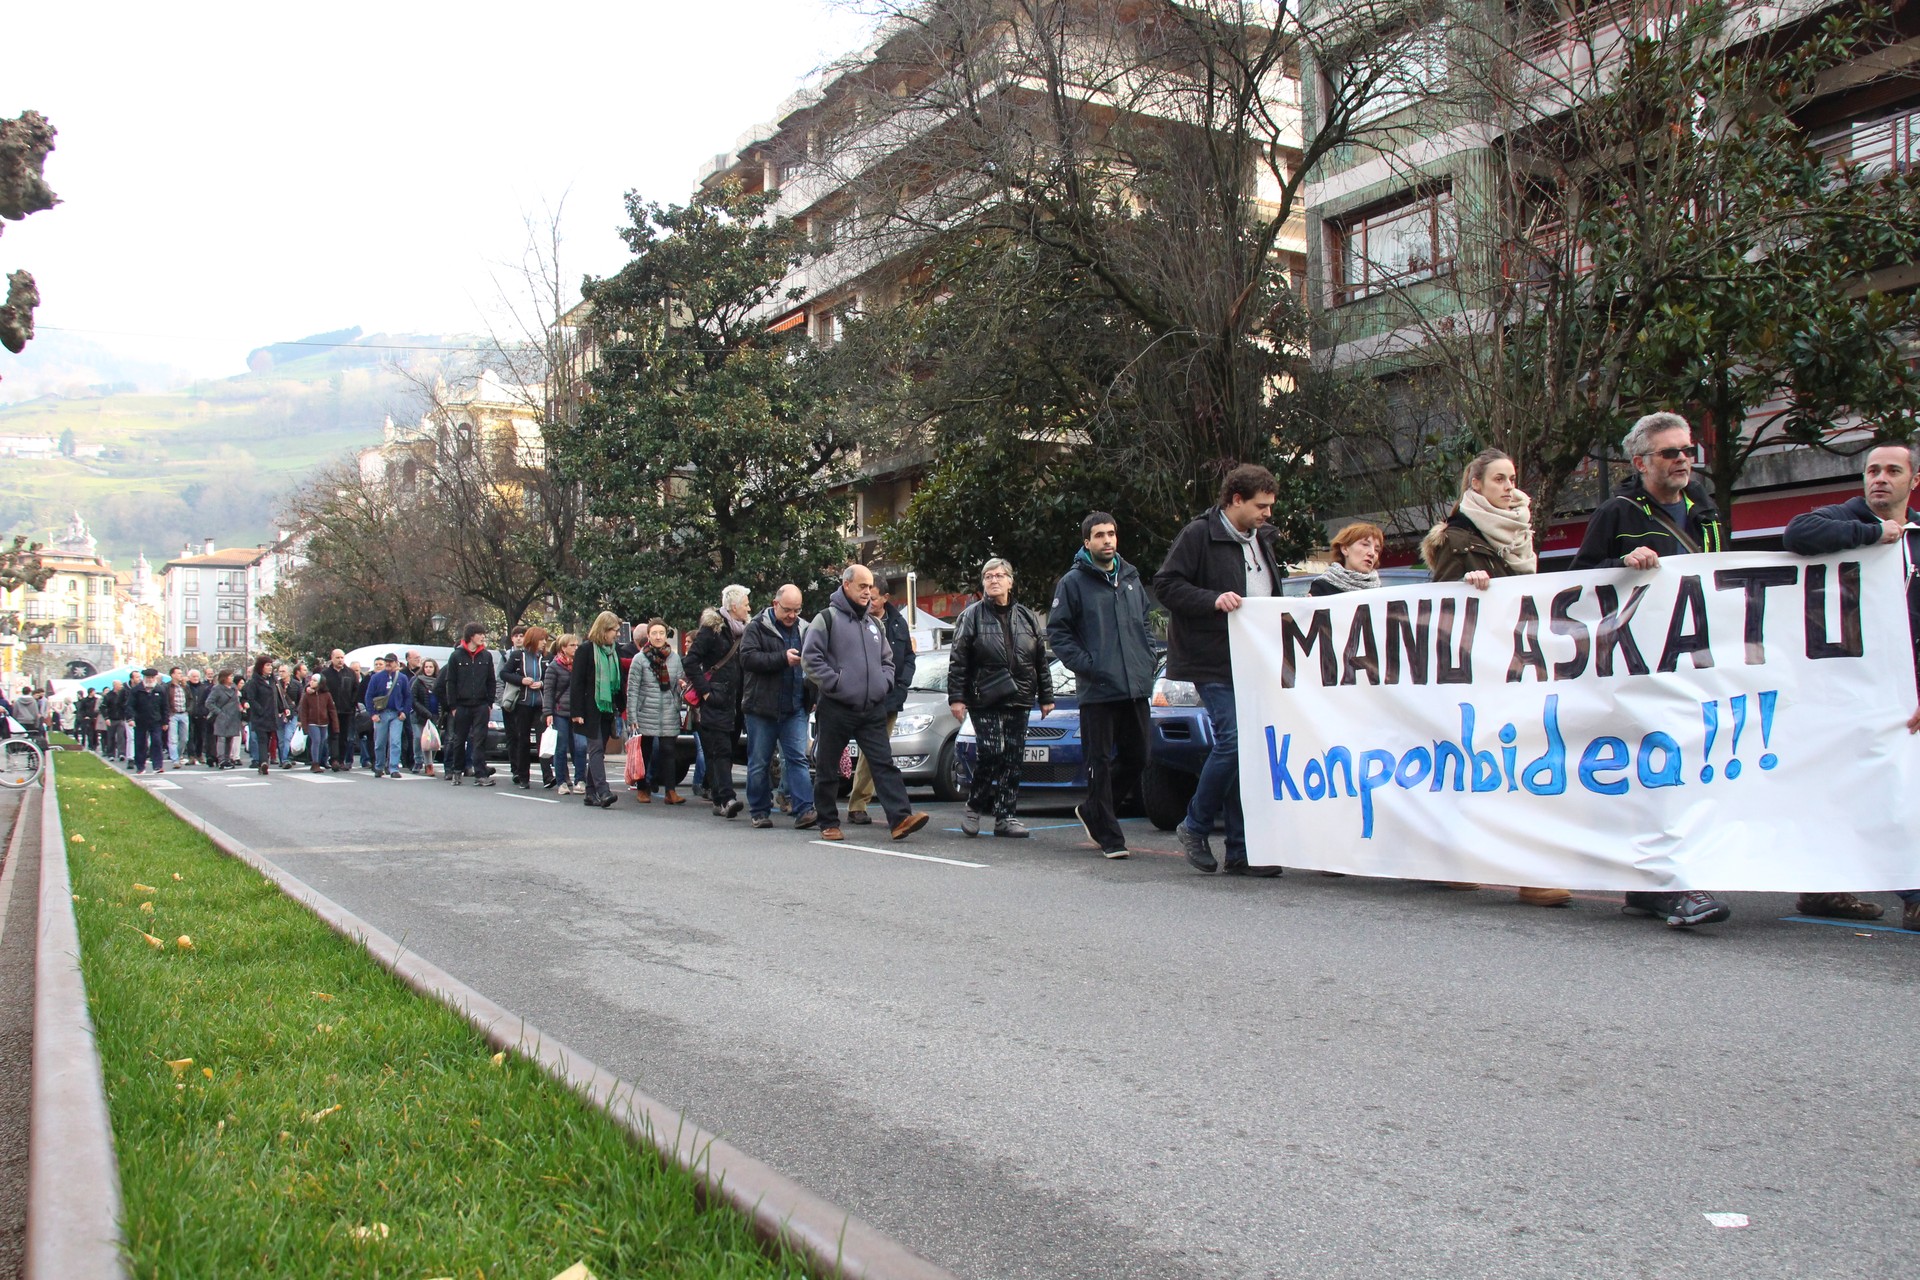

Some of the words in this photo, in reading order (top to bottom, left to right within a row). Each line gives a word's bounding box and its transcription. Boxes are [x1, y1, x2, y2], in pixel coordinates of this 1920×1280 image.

[1280, 598, 1480, 689] MANU
[1504, 561, 1865, 683] ASKATU
[1024, 749, 1045, 761] FNP
